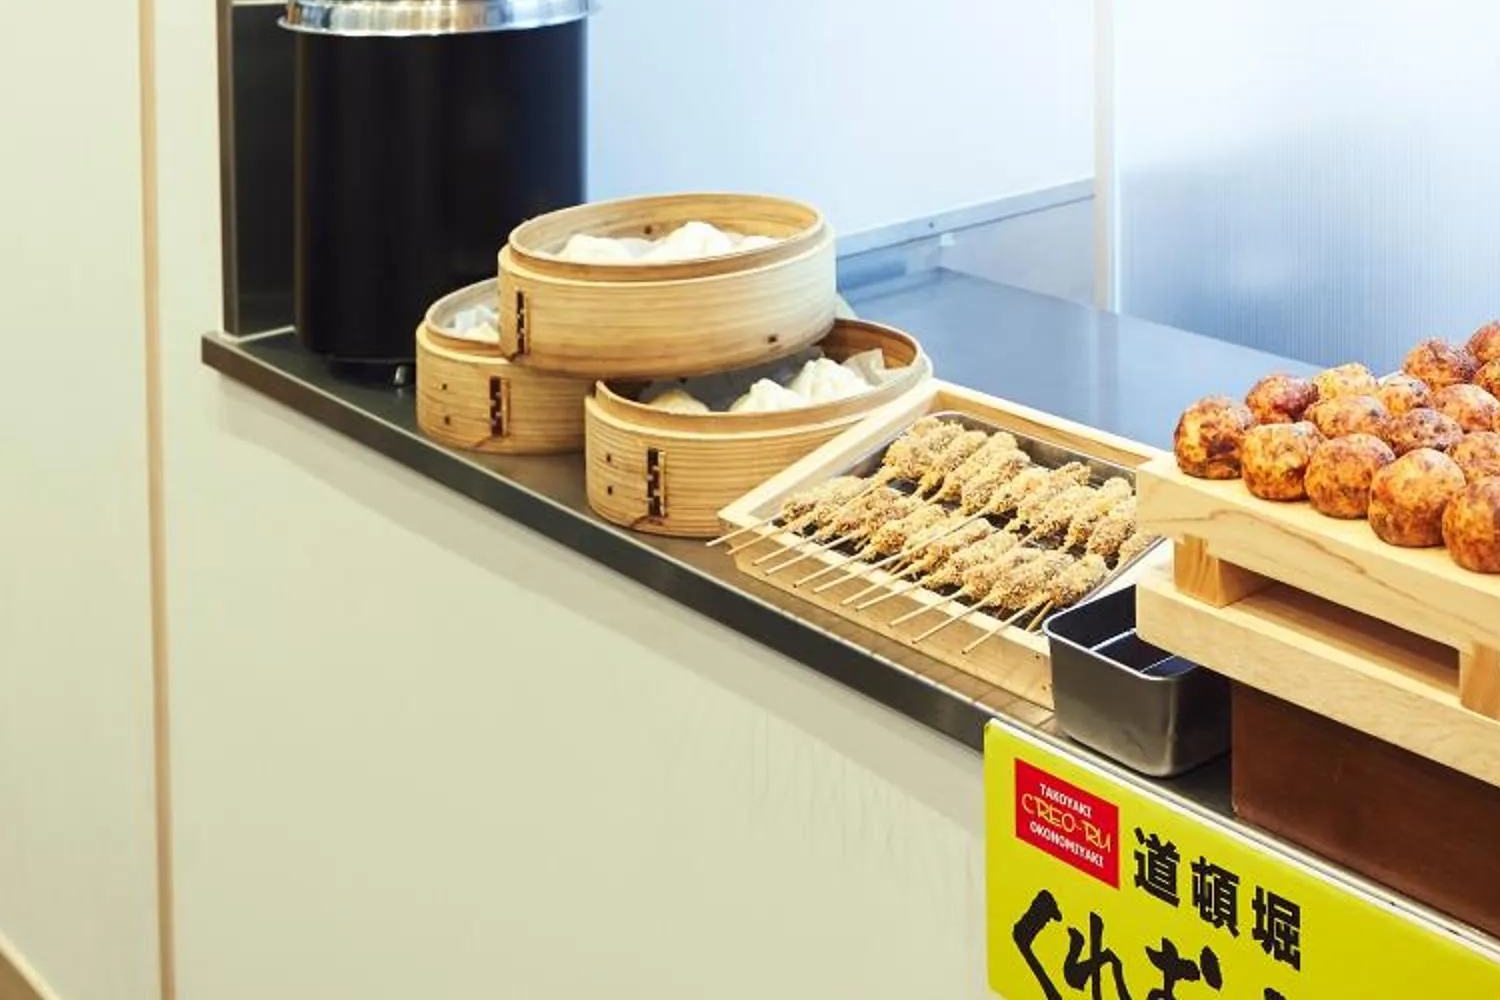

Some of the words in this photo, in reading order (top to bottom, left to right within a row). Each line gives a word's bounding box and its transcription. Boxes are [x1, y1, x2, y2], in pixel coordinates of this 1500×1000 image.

[1040, 783, 1093, 819] TAKOYAKI
[1029, 821, 1105, 869] OKONOMIYAKI
[1134, 826, 1301, 972] 道頓堀
